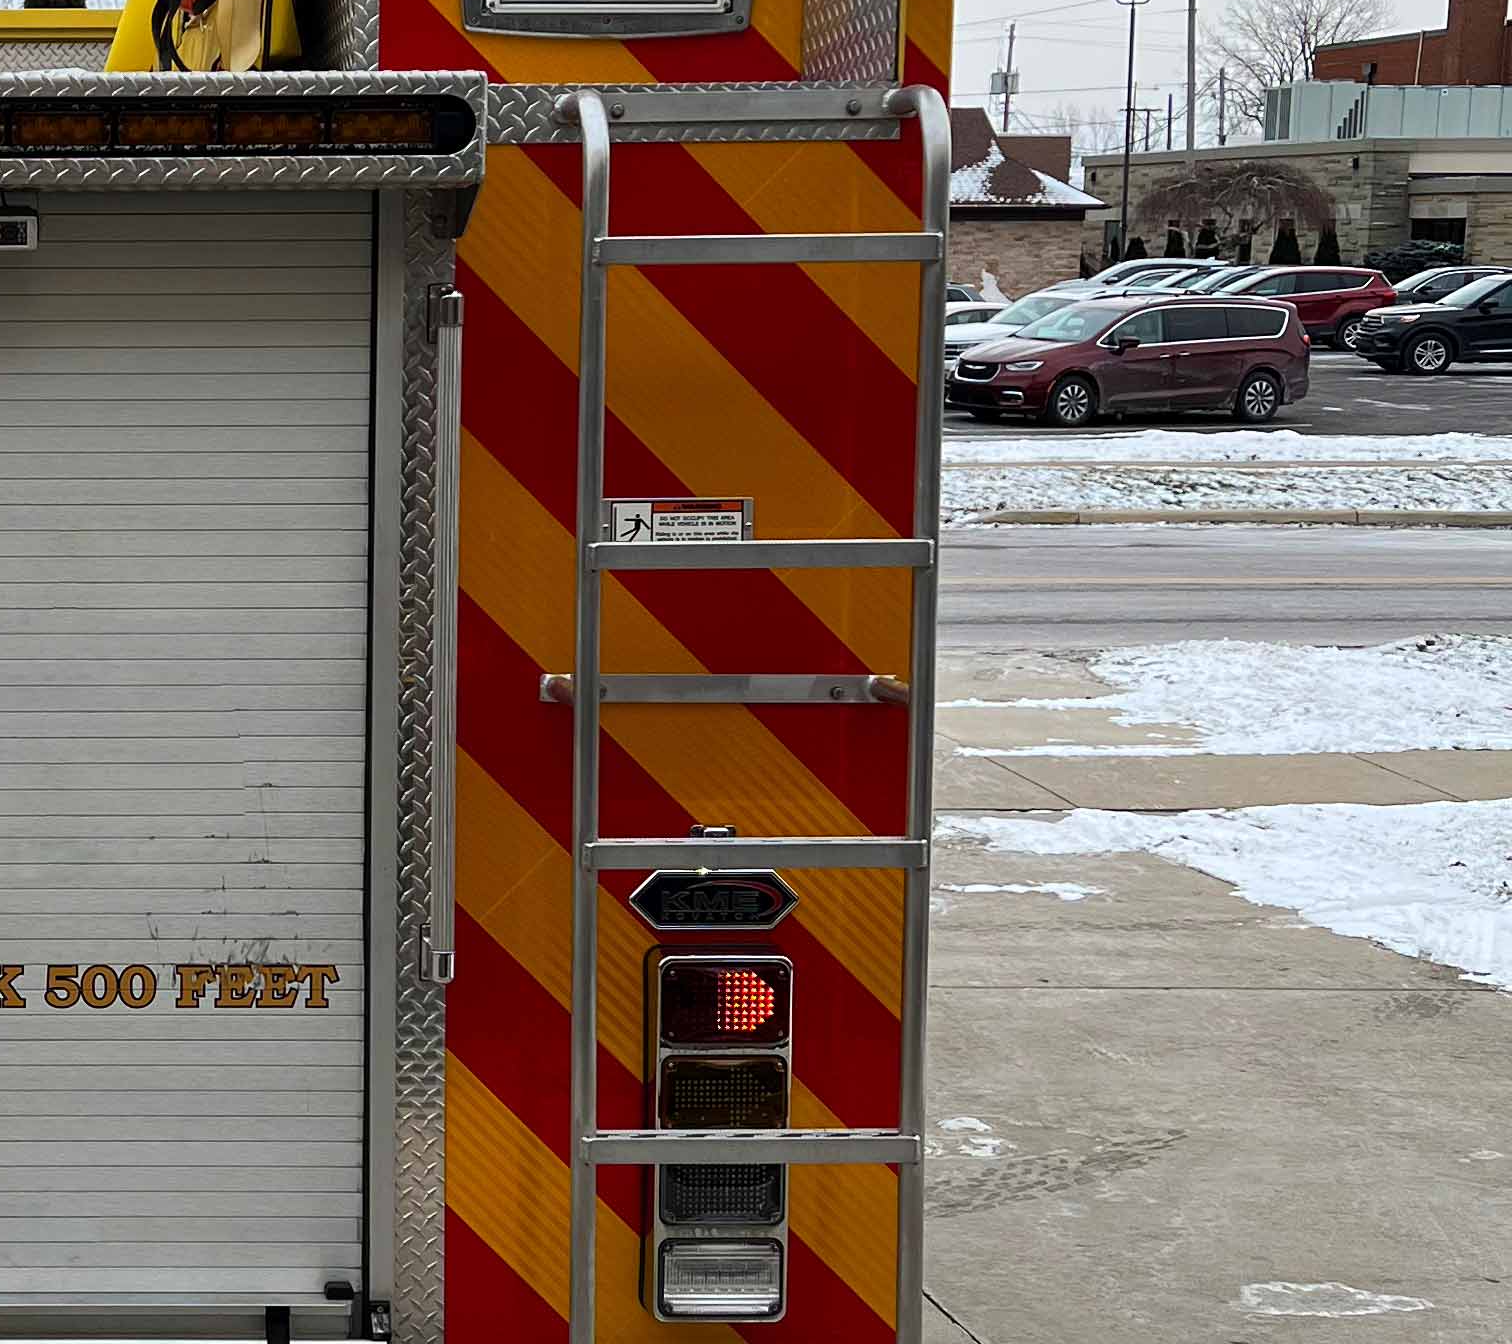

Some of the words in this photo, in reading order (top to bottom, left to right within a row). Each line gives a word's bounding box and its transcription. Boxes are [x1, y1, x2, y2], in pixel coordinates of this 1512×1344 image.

[661, 890, 760, 912] KME
[44, 964, 158, 1010] 500
[175, 964, 340, 1010] FEET
